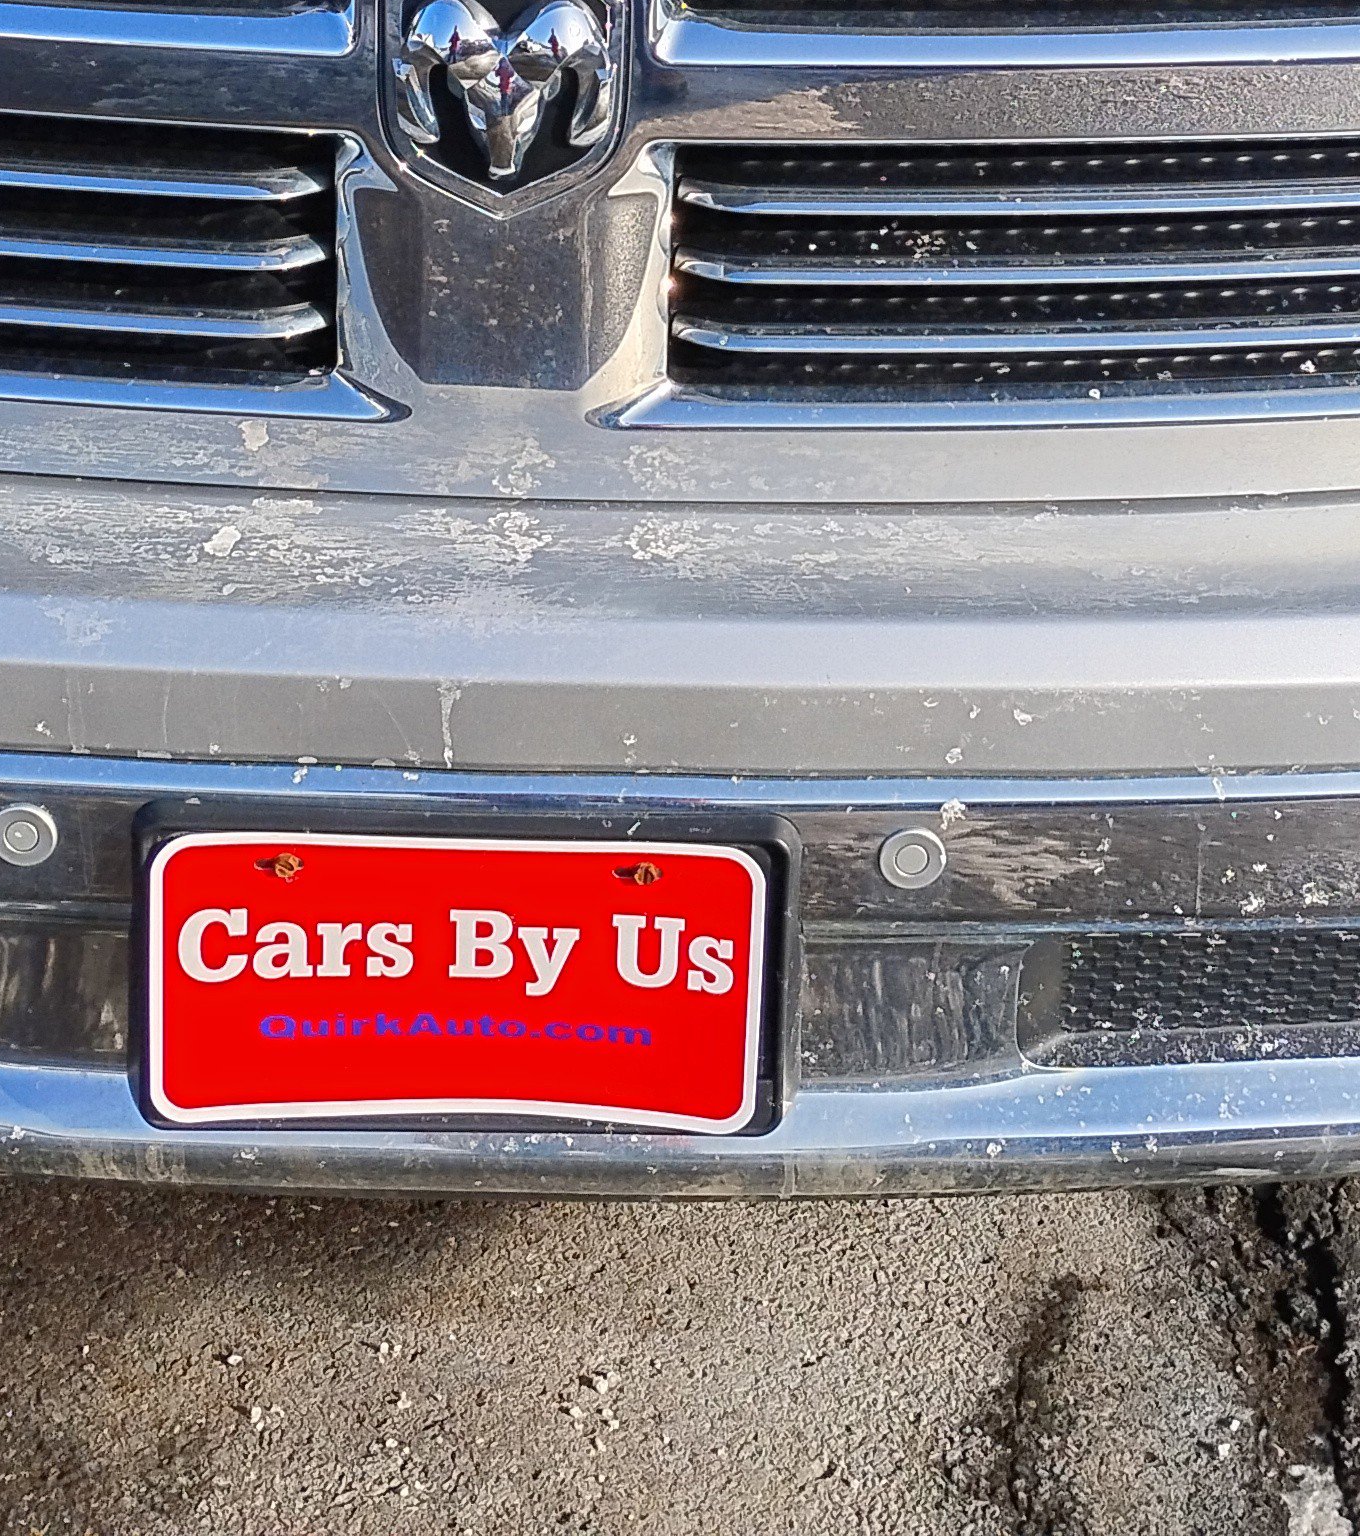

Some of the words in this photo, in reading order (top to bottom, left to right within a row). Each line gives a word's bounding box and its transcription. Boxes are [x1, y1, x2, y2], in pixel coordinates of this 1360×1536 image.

[177, 908, 414, 983] Cars
[448, 908, 580, 997] By
[611, 913, 735, 995] Us
[258, 1013, 653, 1046] QuirkAuto.com
